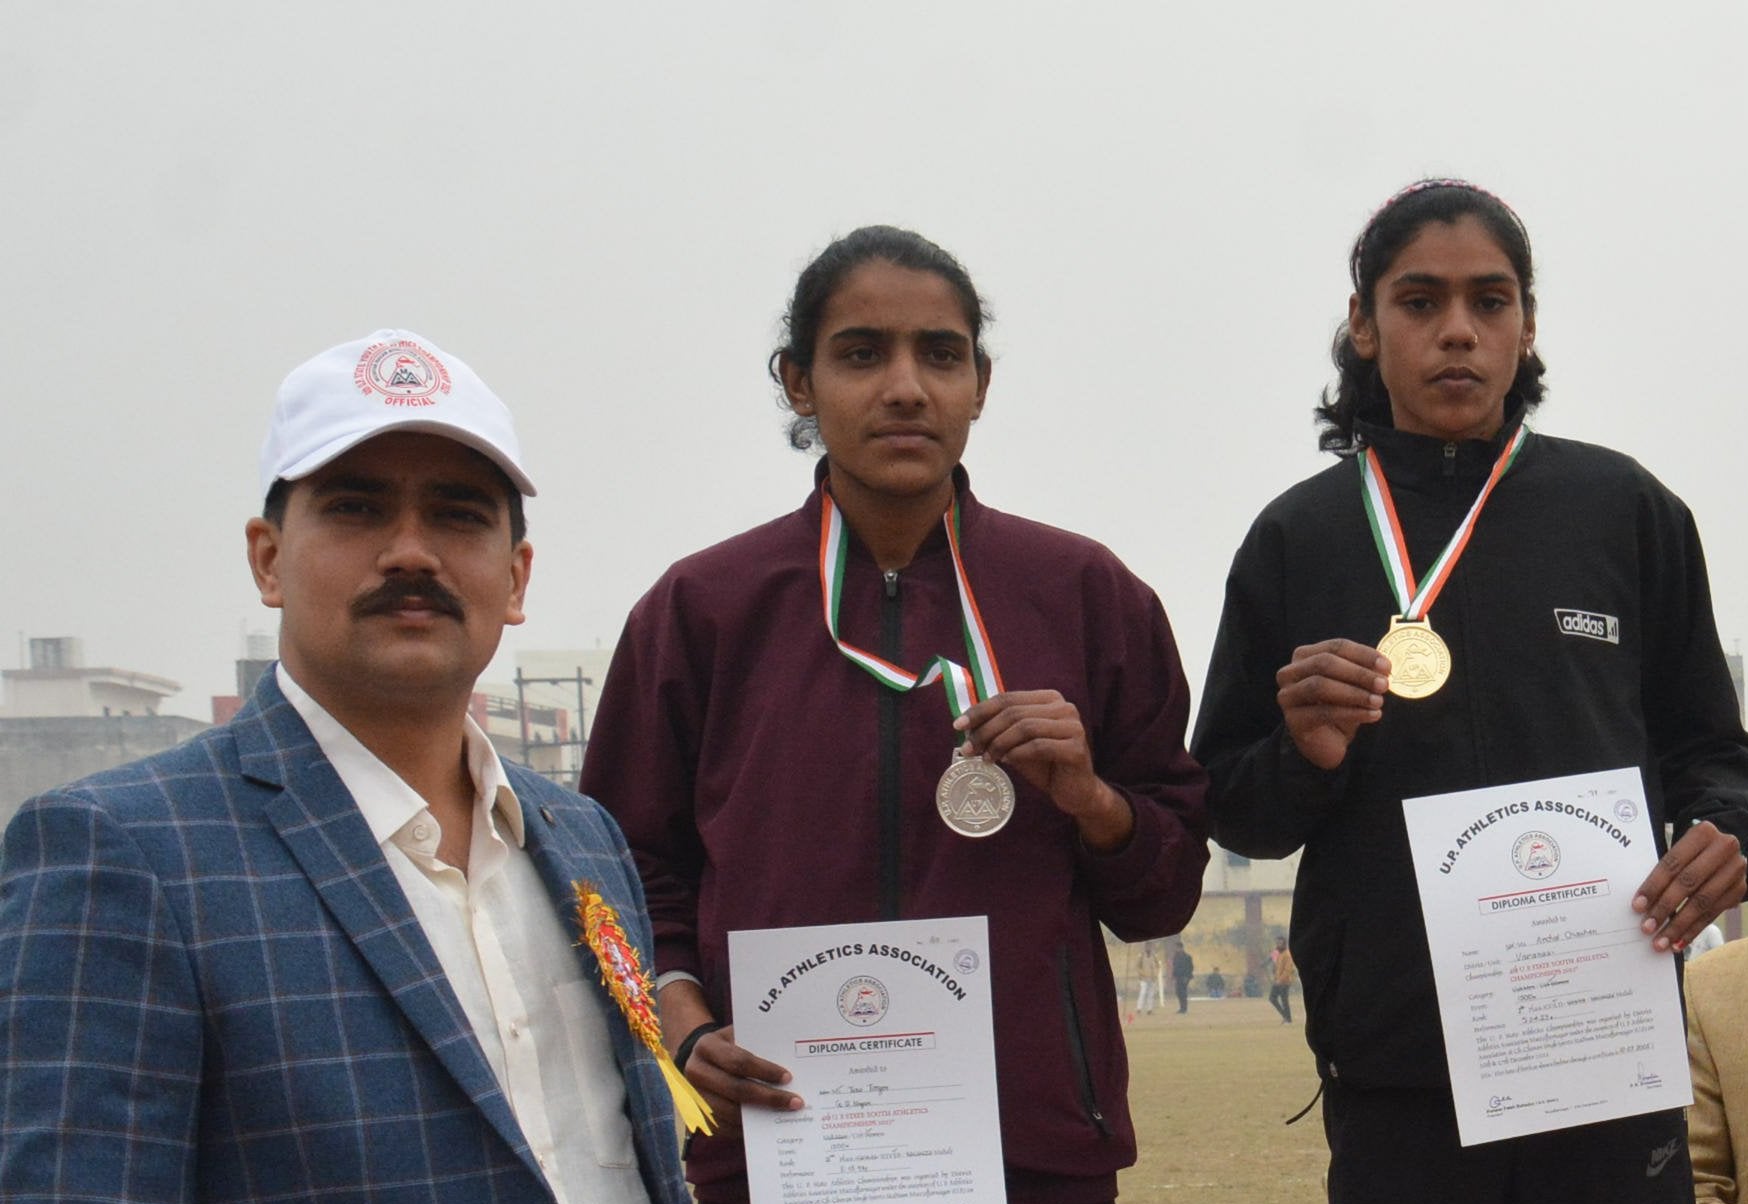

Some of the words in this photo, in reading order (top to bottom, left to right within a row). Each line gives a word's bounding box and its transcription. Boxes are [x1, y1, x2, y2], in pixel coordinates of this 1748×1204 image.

[384, 397, 435, 407] OFFICIAL
[1563, 614, 1604, 636] adidas
[1439, 850, 1460, 875] U.P.
[1456, 801, 1529, 849] ATHLETICS
[1534, 800, 1631, 848] ASSOCIATION
[1491, 895, 1536, 911] DIPLOMA
[1538, 885, 1598, 903] CERTIFICATE
[758, 988, 782, 1013] U.P.
[780, 943, 863, 988] ATHLETICS
[868, 944, 966, 1001] ASSOCIATION
[808, 1041, 857, 1054] DIPLOMA
[859, 1037, 923, 1050] CERTIFICATE
